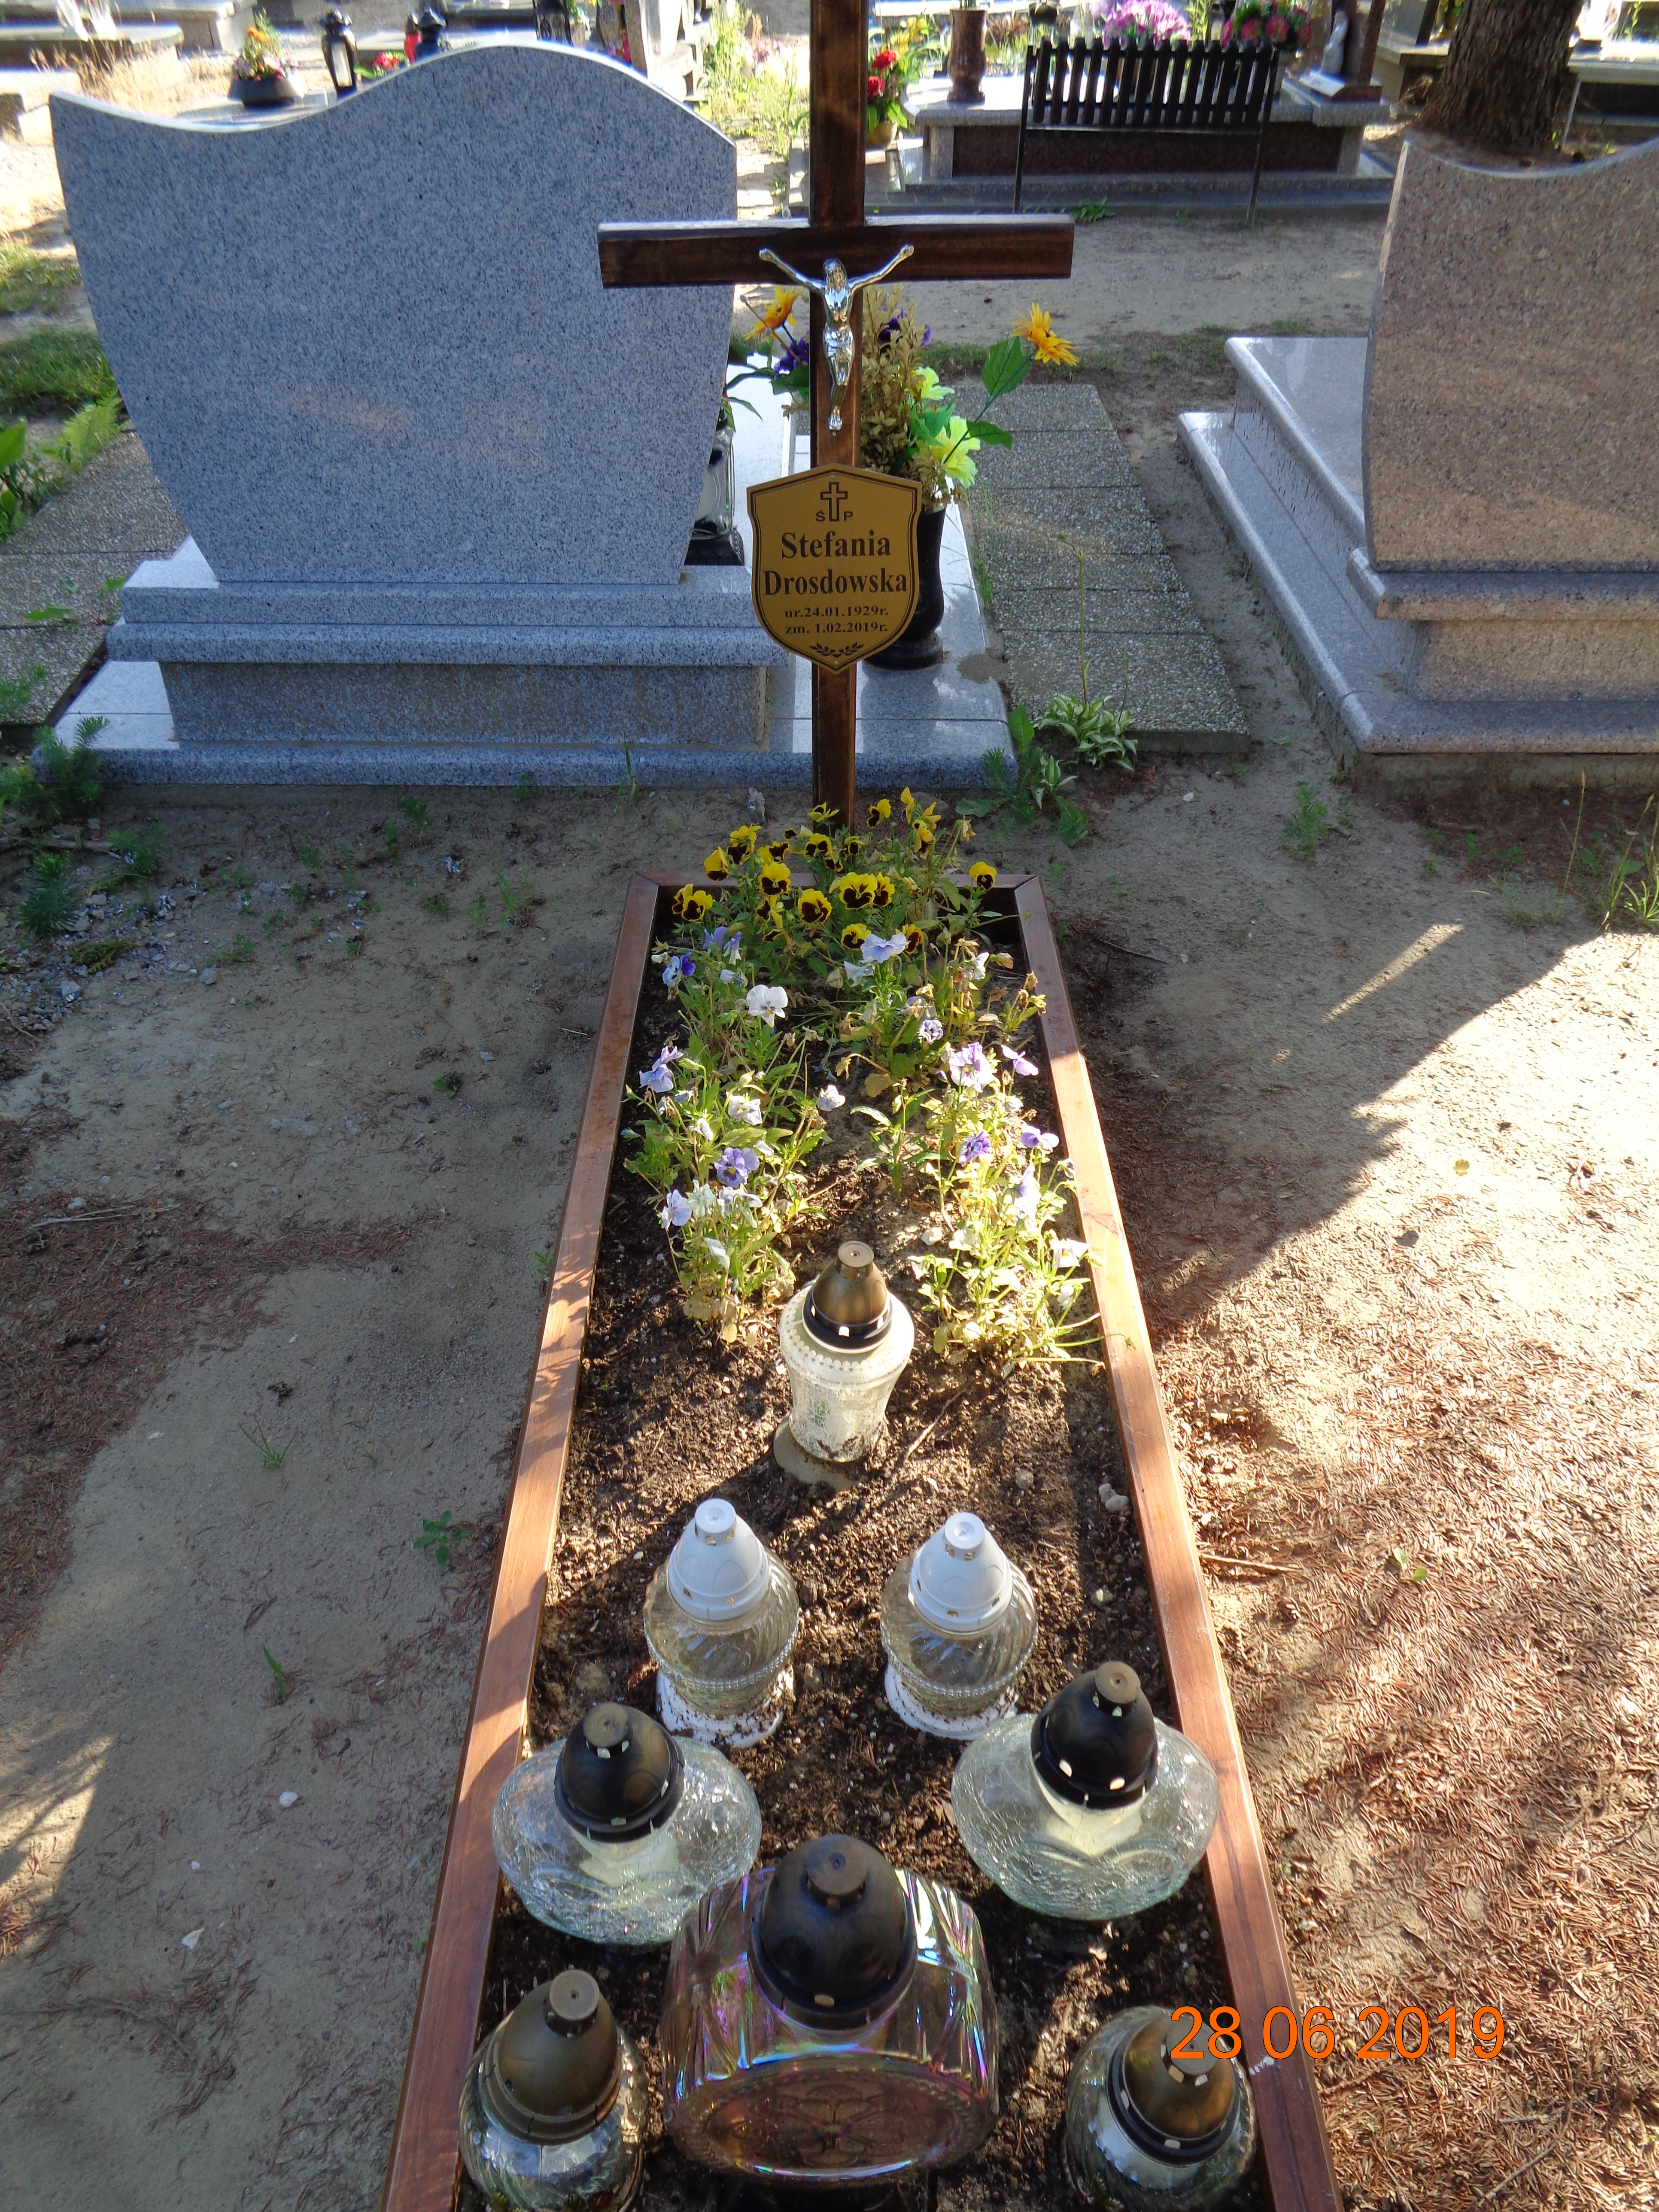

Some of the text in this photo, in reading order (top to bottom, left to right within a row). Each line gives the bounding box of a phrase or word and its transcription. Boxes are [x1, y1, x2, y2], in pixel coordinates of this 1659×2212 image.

[815, 510, 853, 522] Ś P
[781, 530, 891, 559] Stefania
[763, 568, 907, 596] Drosdowska
[785, 621, 888, 635] zm. 1.02.2019r.
